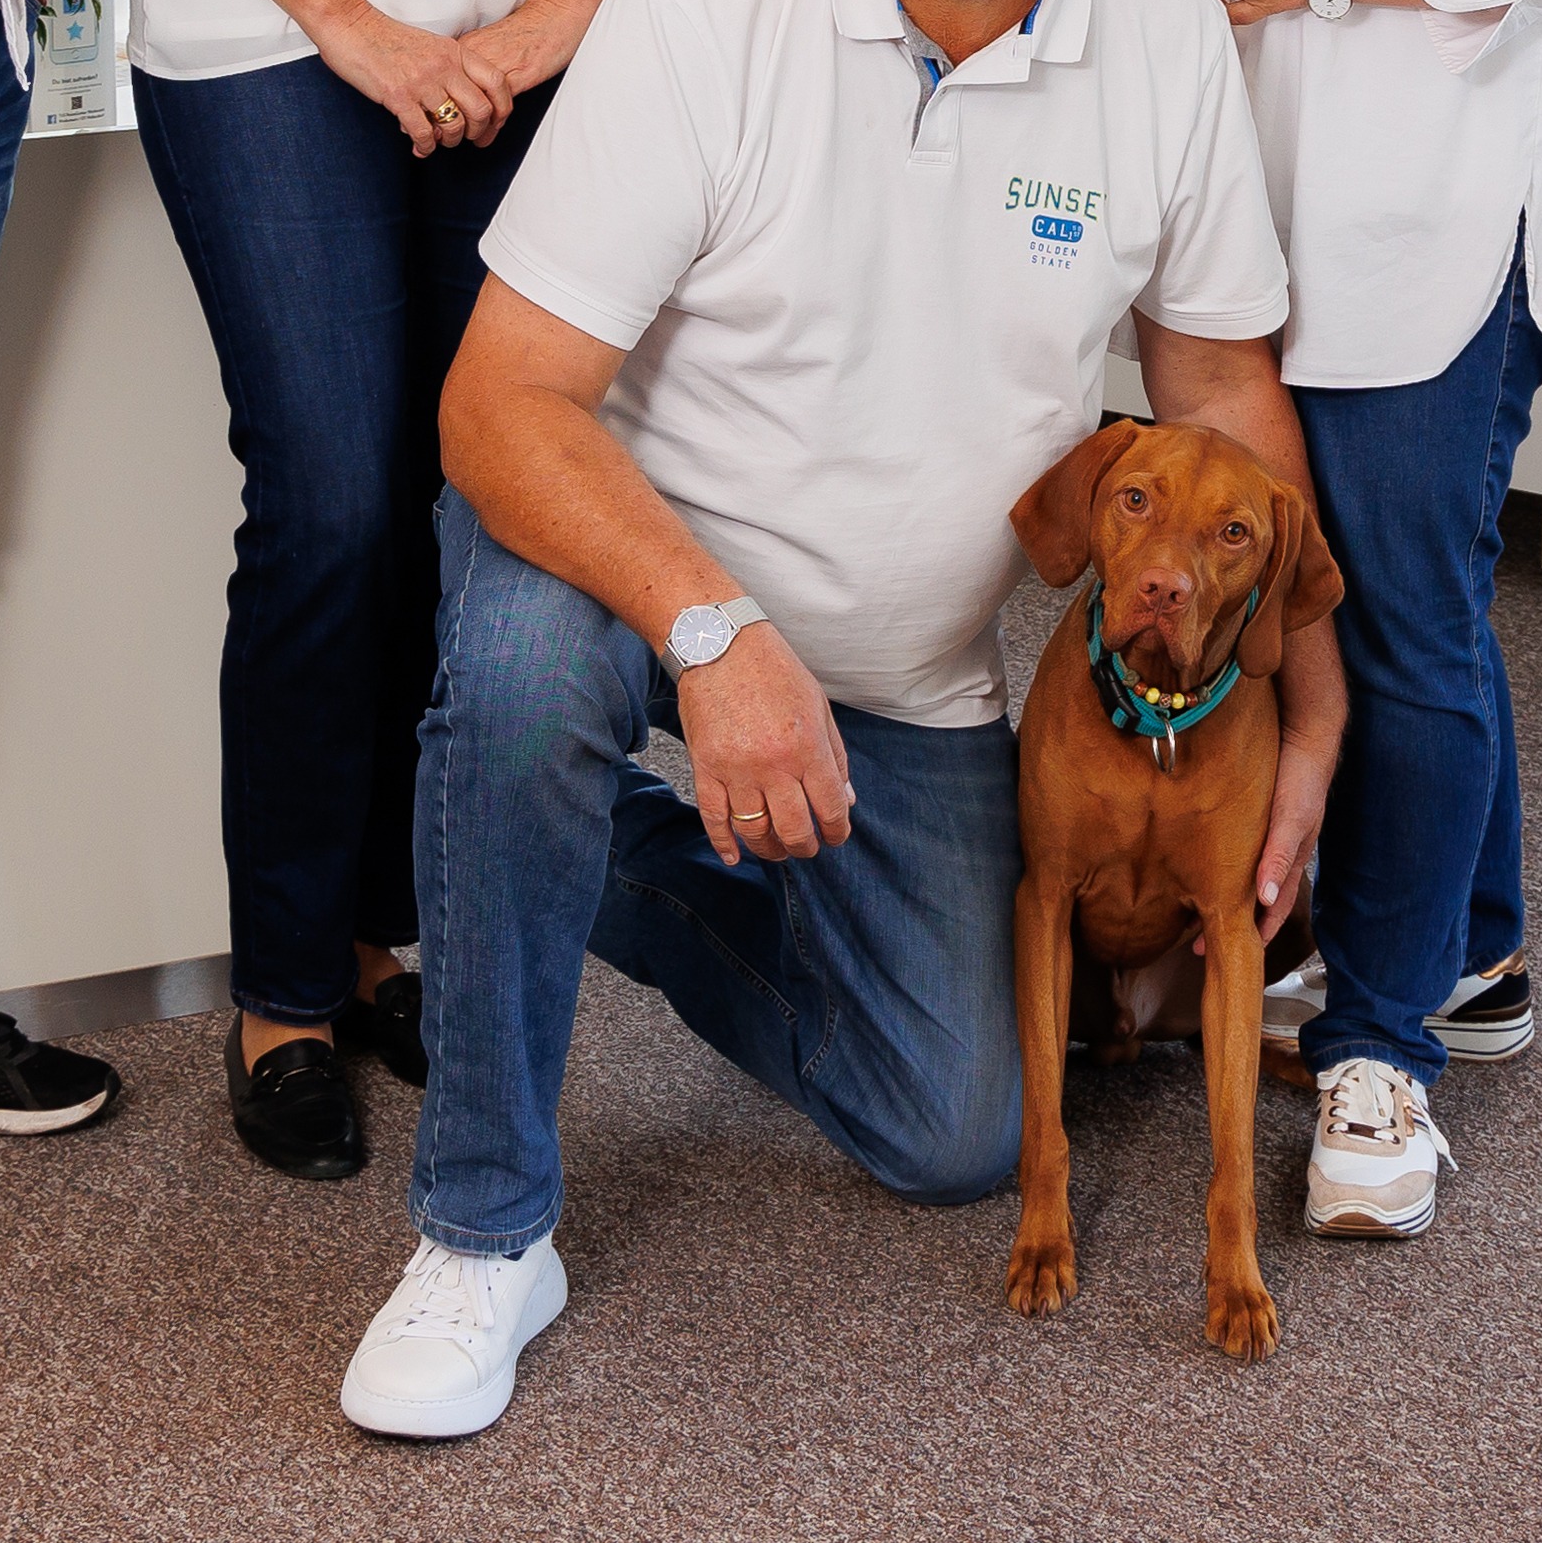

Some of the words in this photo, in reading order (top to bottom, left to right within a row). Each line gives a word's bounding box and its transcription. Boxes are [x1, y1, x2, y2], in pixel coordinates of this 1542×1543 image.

[1005, 177, 1107, 222] SUNSE
[1029, 241, 1078, 257] GOLDEN
[1031, 254, 1071, 269] STATE
